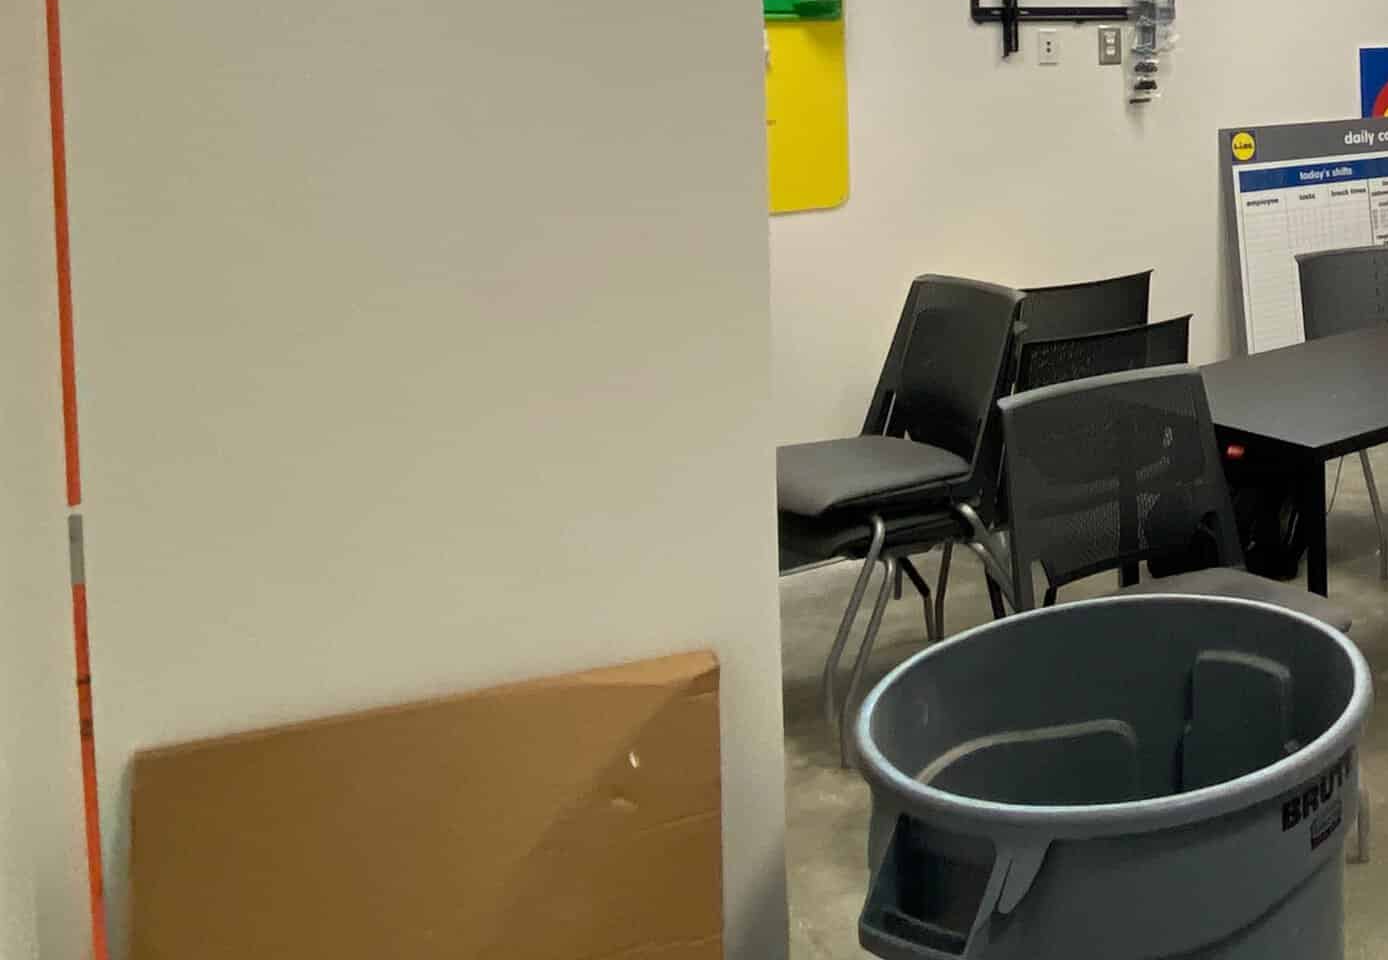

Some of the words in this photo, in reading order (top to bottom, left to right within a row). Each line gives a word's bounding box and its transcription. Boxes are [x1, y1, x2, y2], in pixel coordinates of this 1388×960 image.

[1344, 130, 1375, 147] daily
[1299, 167, 1331, 181] today's
[1331, 166, 1353, 177] shifts
